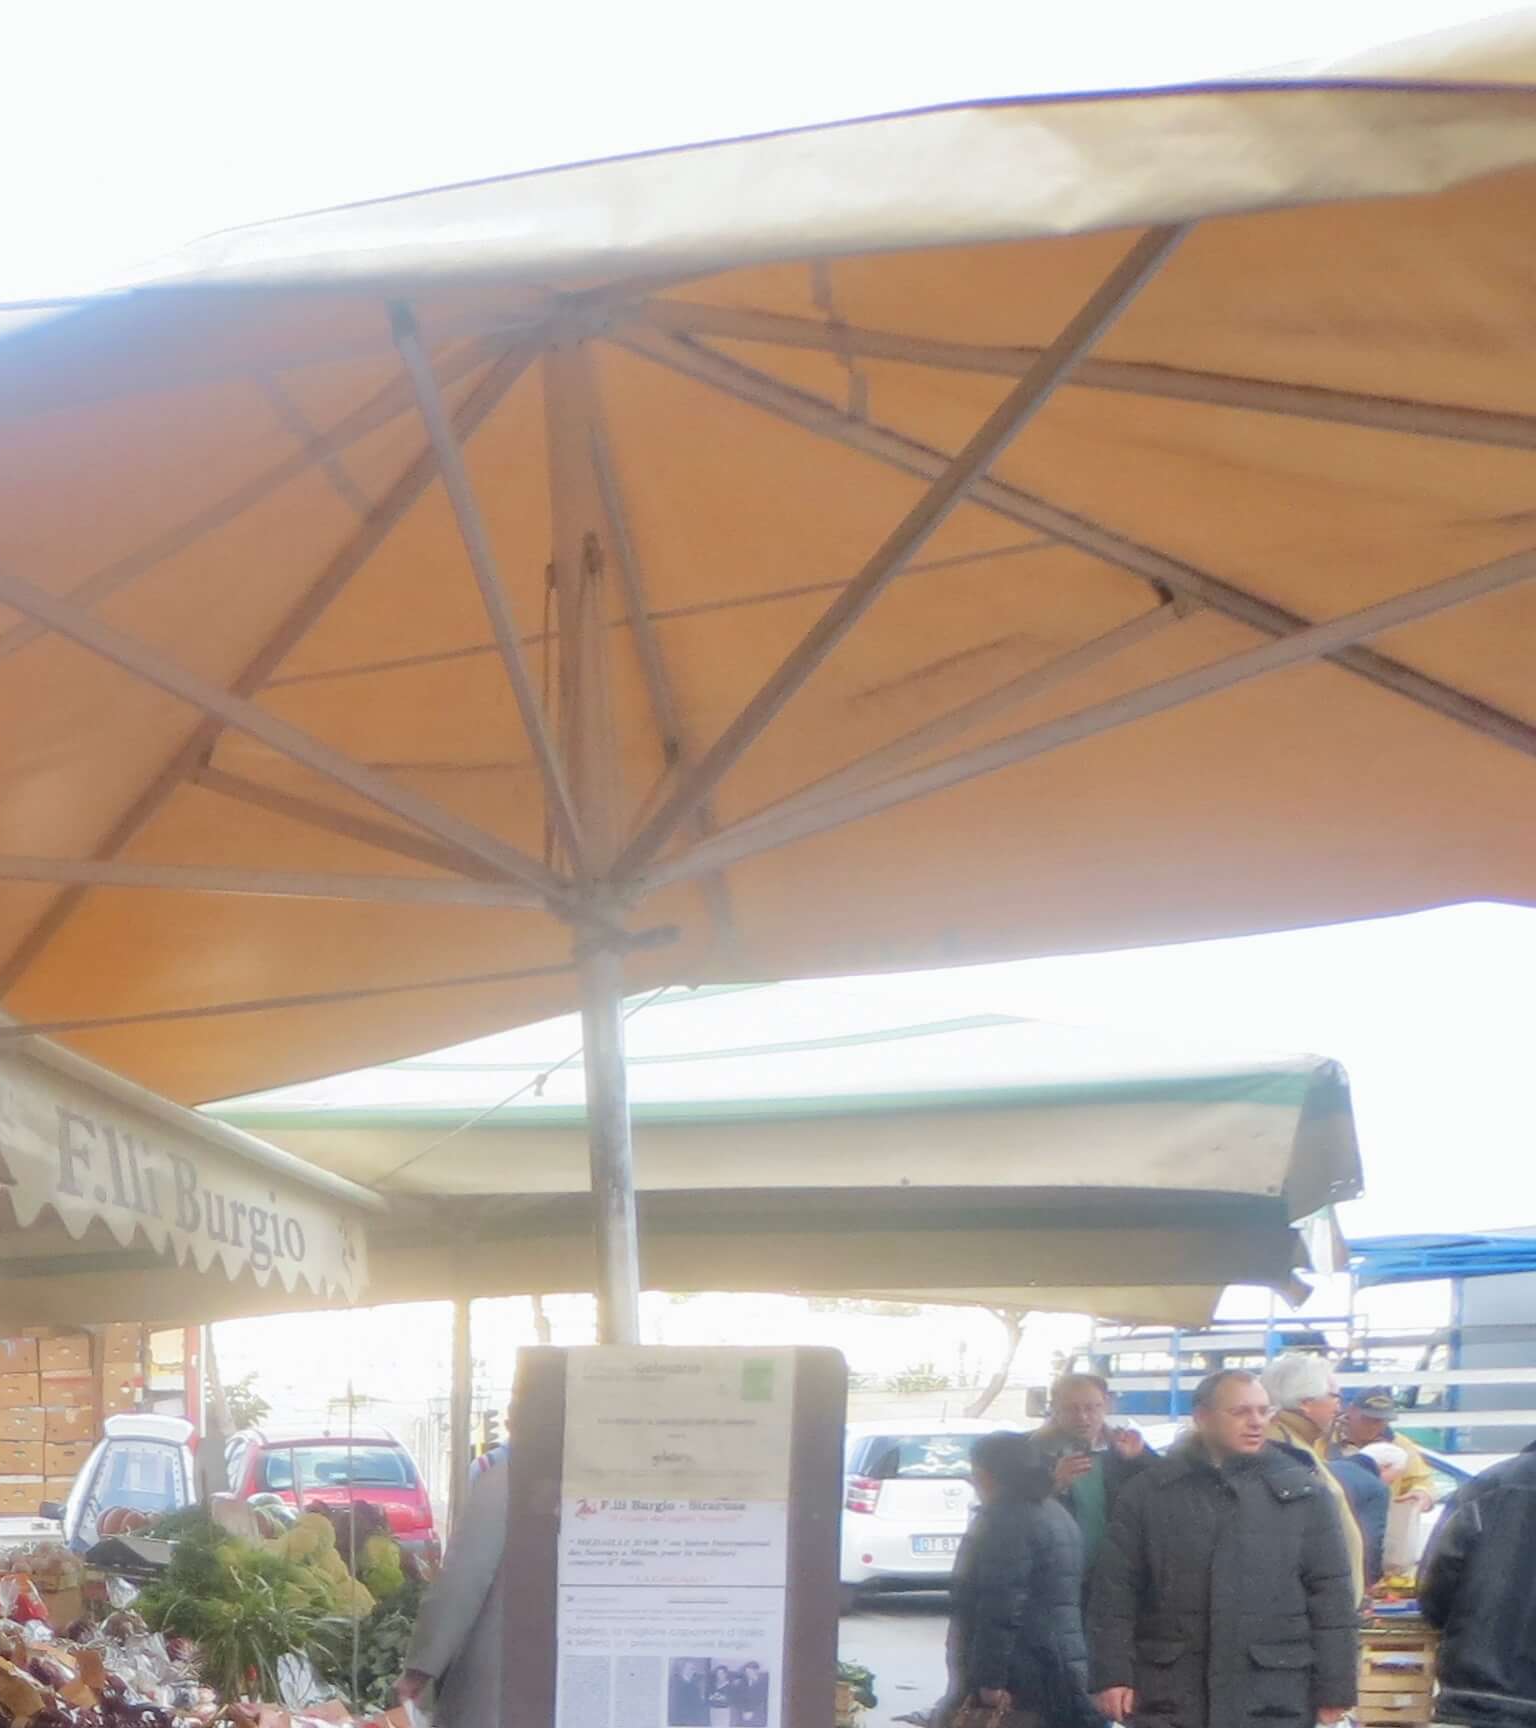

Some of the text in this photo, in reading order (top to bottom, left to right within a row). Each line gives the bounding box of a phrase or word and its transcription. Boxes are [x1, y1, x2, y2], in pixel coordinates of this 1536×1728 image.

[56, 1106, 307, 1271] F.lli Burgio
[632, 1500, 675, 1513] Burgio
